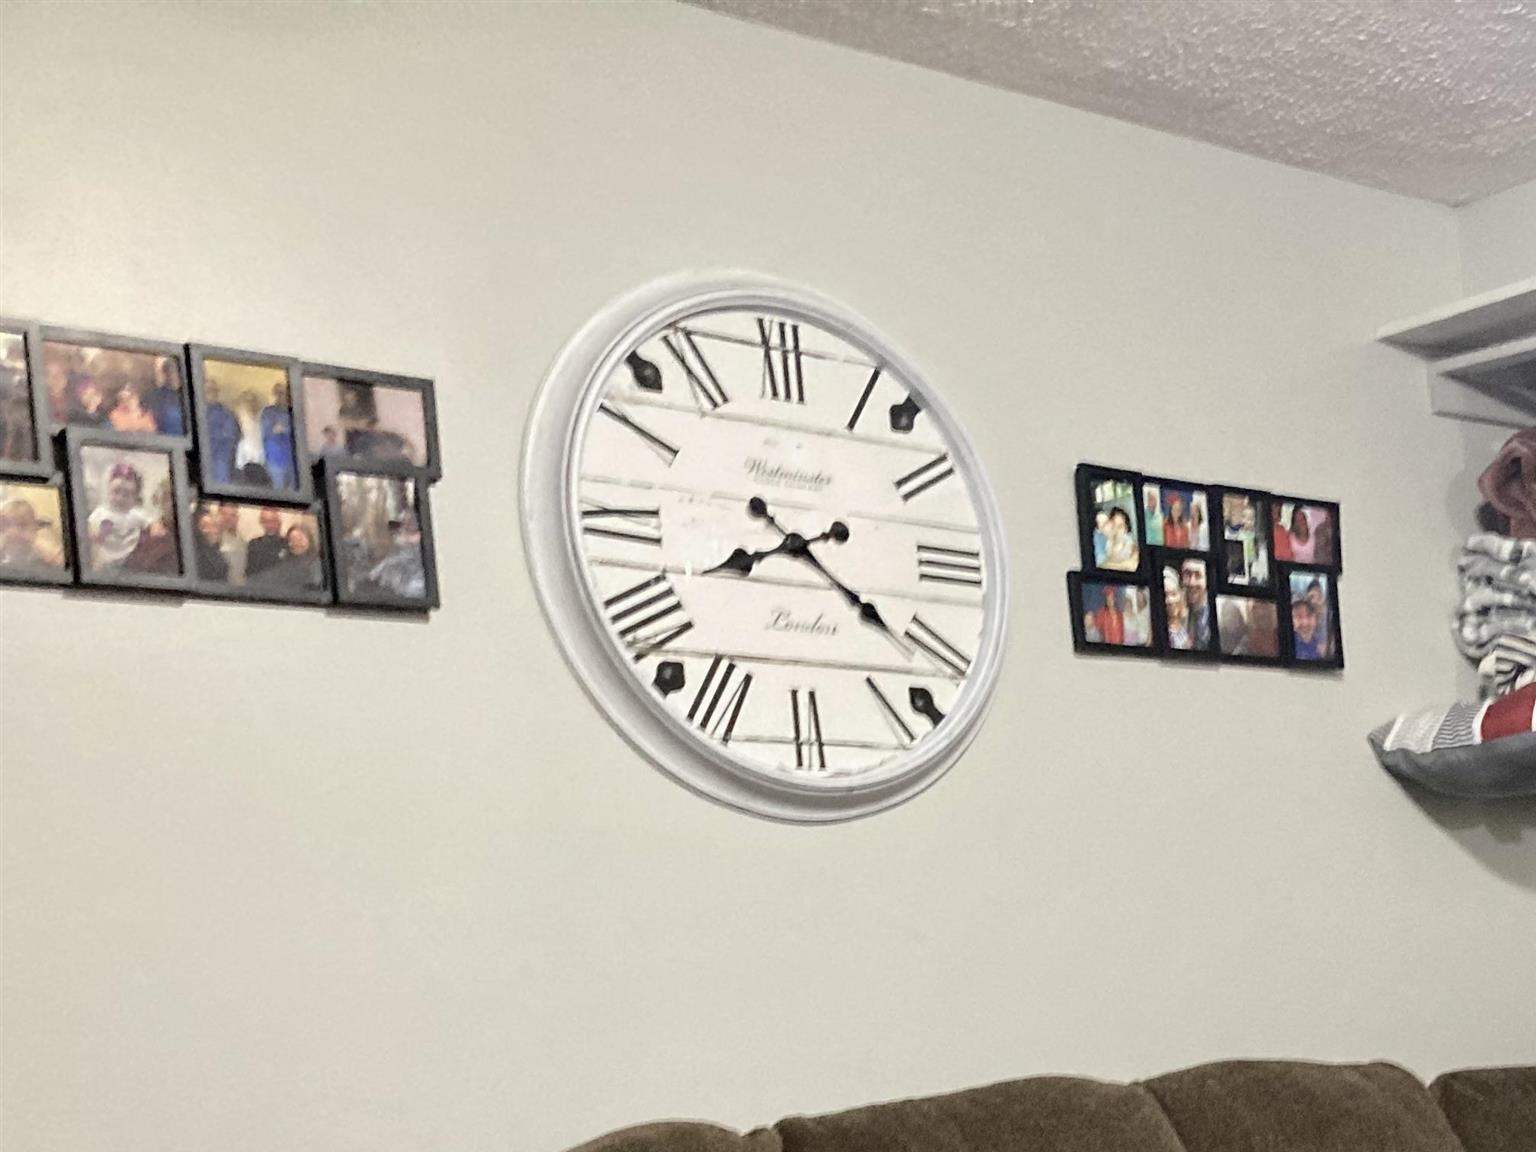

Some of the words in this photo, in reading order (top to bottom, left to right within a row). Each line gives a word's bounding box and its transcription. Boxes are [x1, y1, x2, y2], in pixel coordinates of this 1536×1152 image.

[846, 366, 883, 432] I
[894, 452, 955, 502] II
[916, 544, 983, 588] III
[764, 605, 838, 636] London
